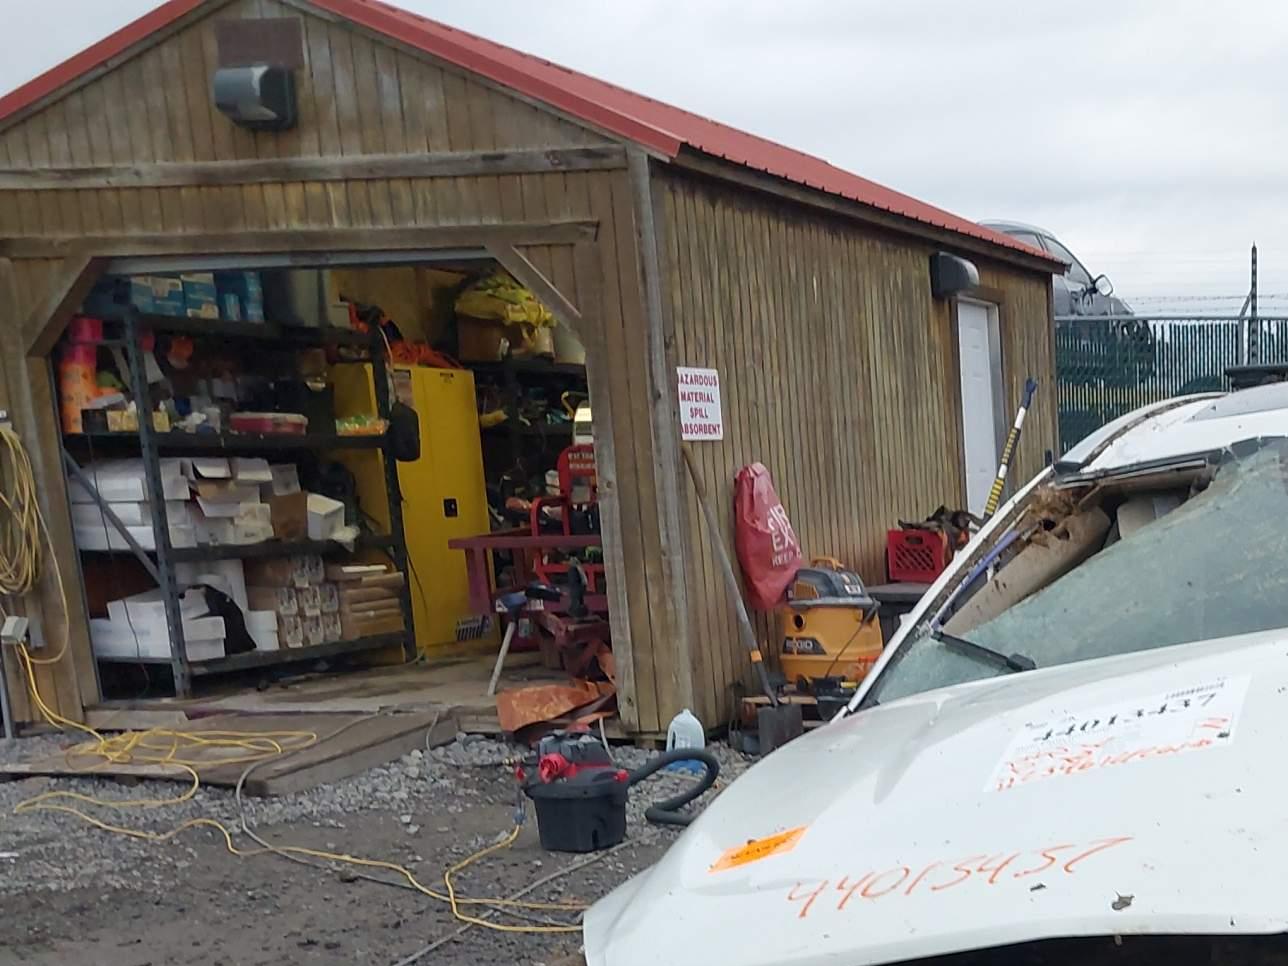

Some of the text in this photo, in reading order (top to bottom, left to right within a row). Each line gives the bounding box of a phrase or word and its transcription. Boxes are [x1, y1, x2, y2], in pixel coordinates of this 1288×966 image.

[678, 373, 718, 387] AZARDOUS
[680, 390, 715, 404] MATERIAL
[689, 406, 709, 419] SPILL
